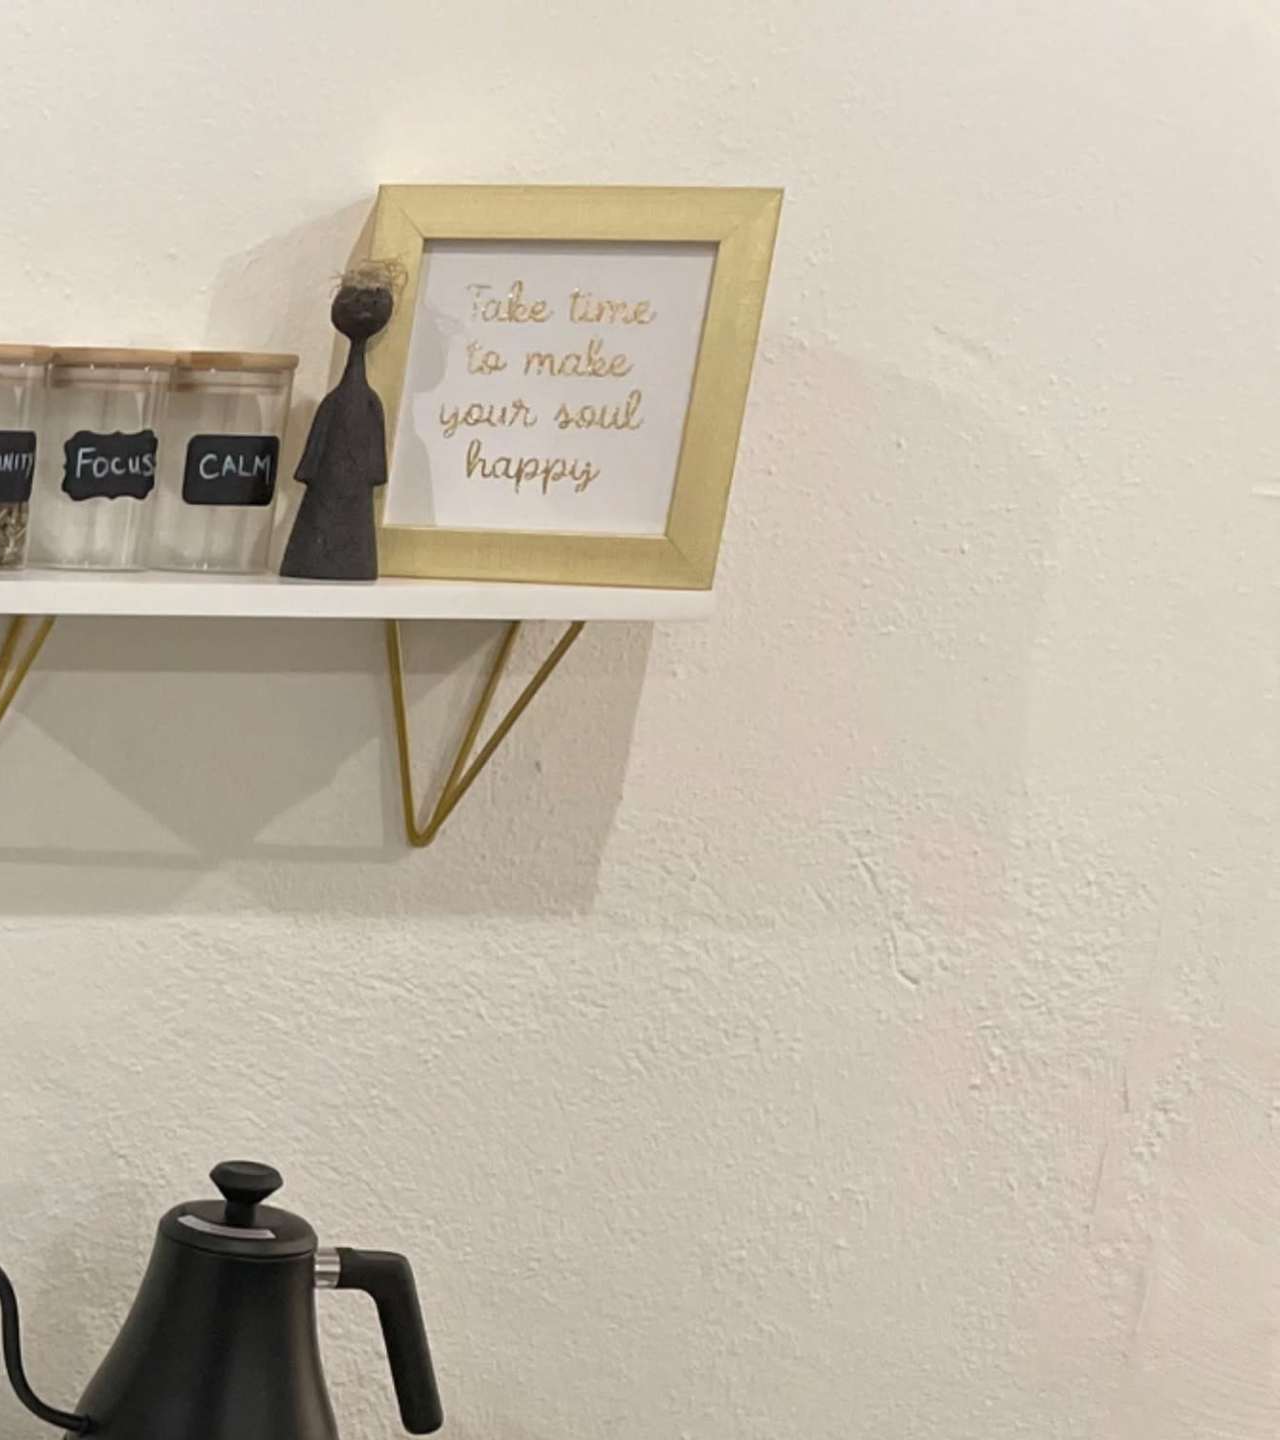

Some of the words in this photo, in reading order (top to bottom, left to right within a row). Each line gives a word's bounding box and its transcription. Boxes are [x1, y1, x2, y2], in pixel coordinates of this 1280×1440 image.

[465, 280, 554, 322] Take
[569, 287, 657, 324] time
[466, 341, 507, 375] to
[523, 337, 634, 377] make
[439, 398, 537, 438] your
[553, 389, 644, 429] soul
[199, 453, 272, 481] CALM
[466, 438, 600, 495] happy
